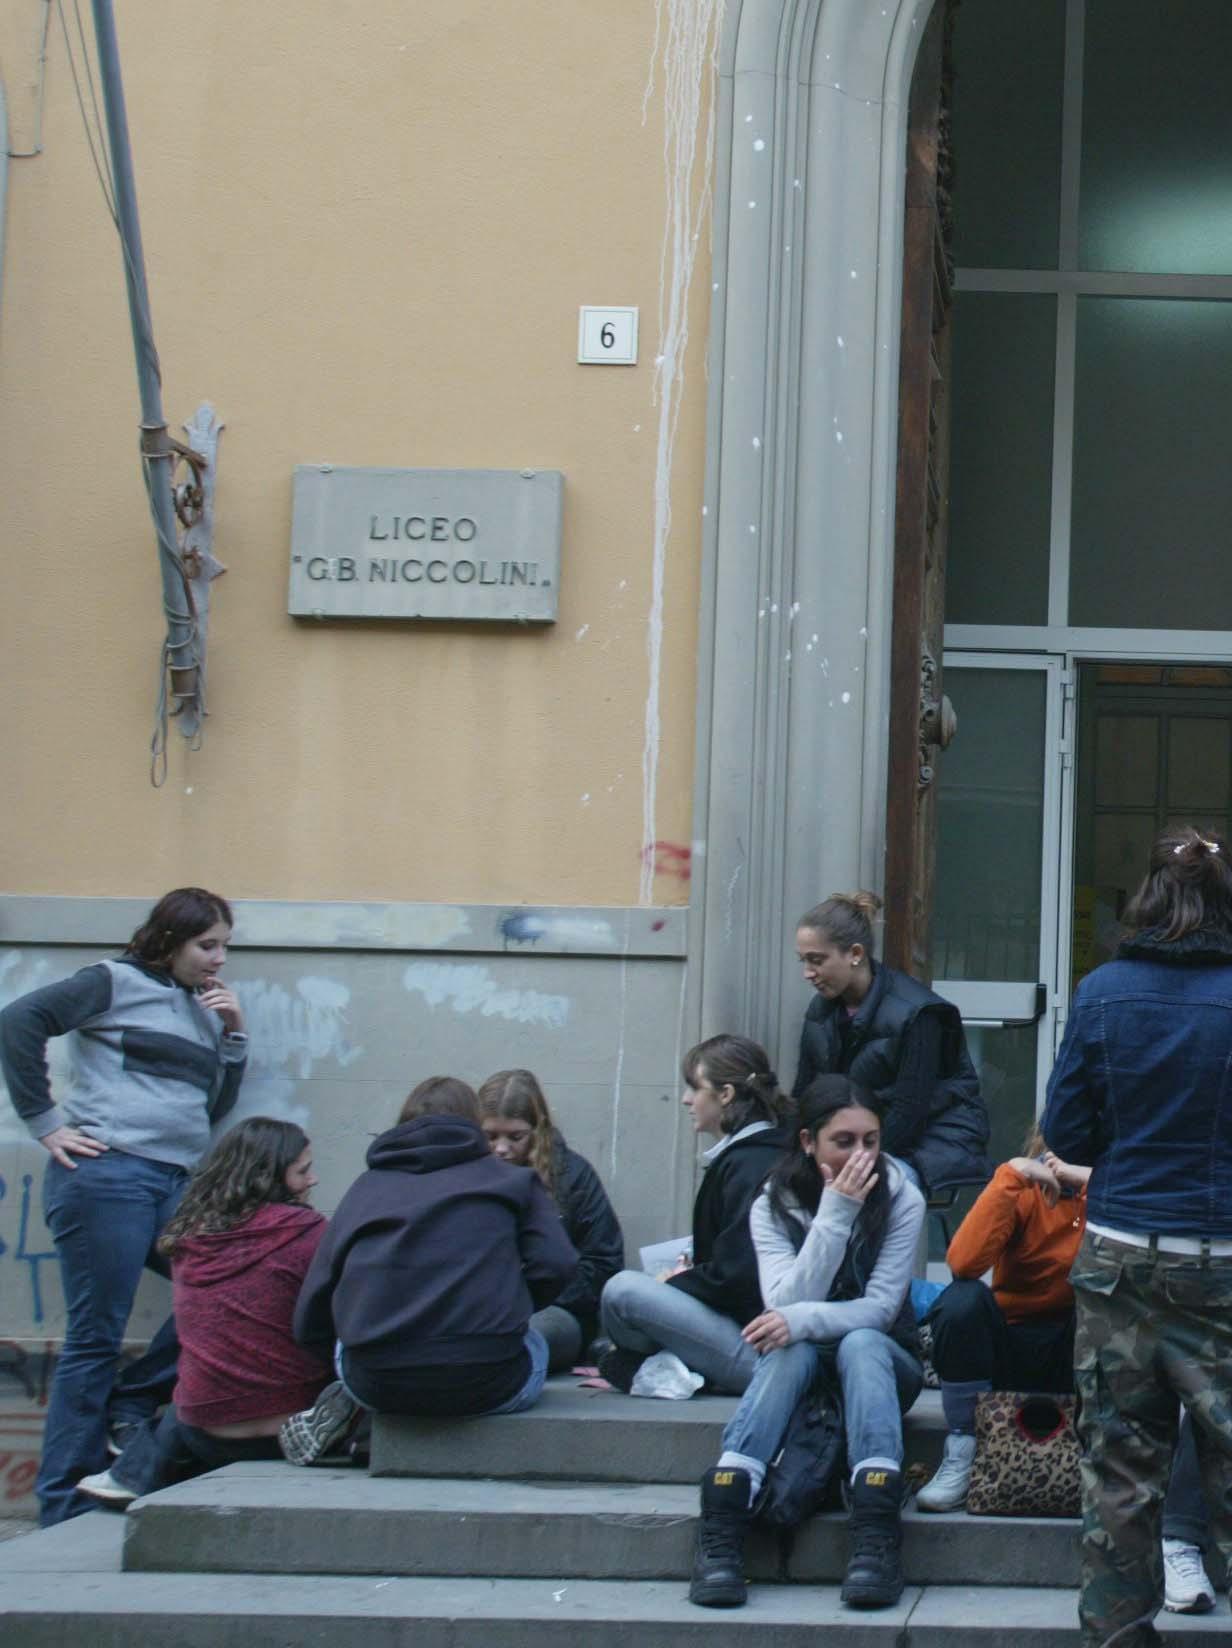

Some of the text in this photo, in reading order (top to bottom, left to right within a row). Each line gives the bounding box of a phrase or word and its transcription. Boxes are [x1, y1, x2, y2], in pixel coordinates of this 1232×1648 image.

[600, 321, 616, 350] 6
[368, 515, 478, 542] LICEO
[713, 1471, 736, 1485] CAT
[865, 1471, 888, 1486] CAT
